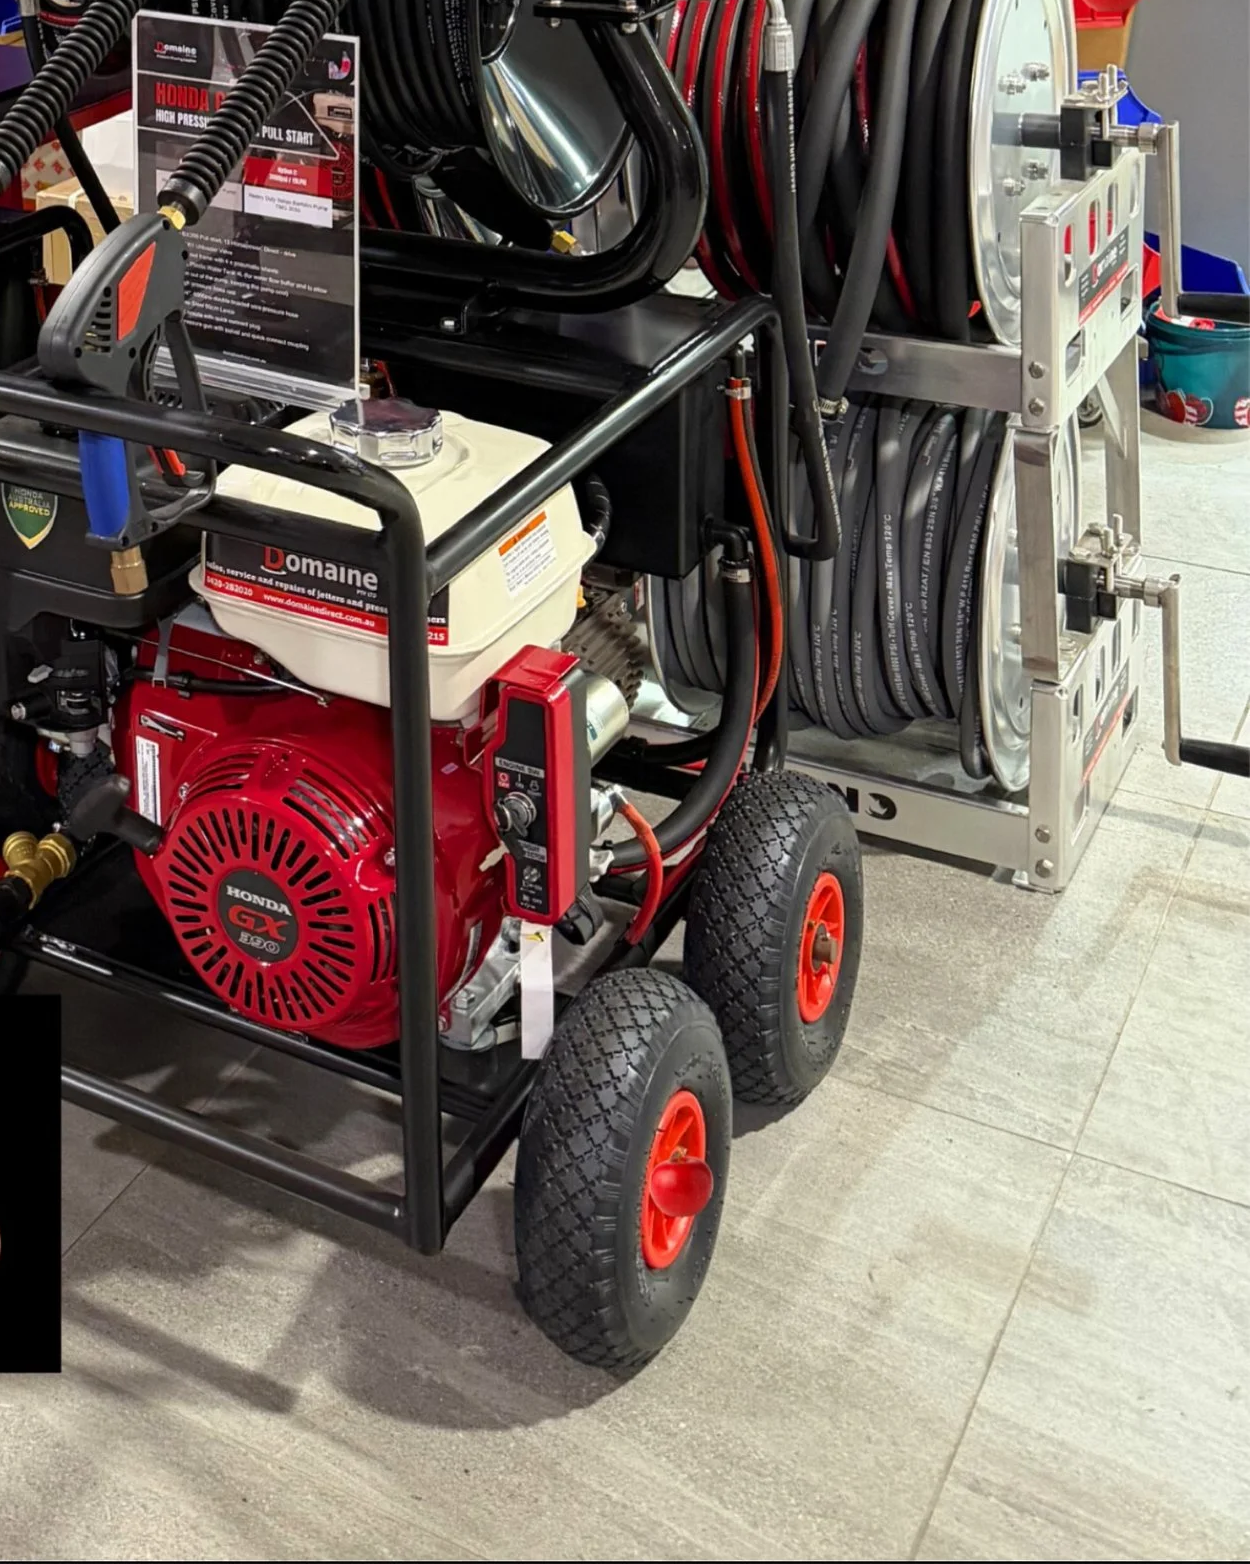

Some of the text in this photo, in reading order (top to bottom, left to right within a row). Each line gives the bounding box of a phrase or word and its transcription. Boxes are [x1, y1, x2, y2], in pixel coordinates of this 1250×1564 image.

[155, 81, 210, 112] HONDA
[155, 109, 175, 125] HIGH
[262, 125, 283, 142] PULL
[285, 128, 314, 146] START
[8, 500, 50, 517] APPROVED
[261, 546, 379, 591] Domaine
[884, 542, 894, 568] Temp
[226, 567, 256, 581] service
[258, 574, 273, 585] and
[275, 580, 305, 594] repairs
[307, 587, 317, 597] of
[317, 588, 345, 604] jetters
[347, 596, 363, 608] and
[263, 592, 375, 628] www.domainedirect.com.au
[226, 883, 293, 917] HONDA
[228, 904, 287, 942] GX
[237, 931, 281, 955] 390
